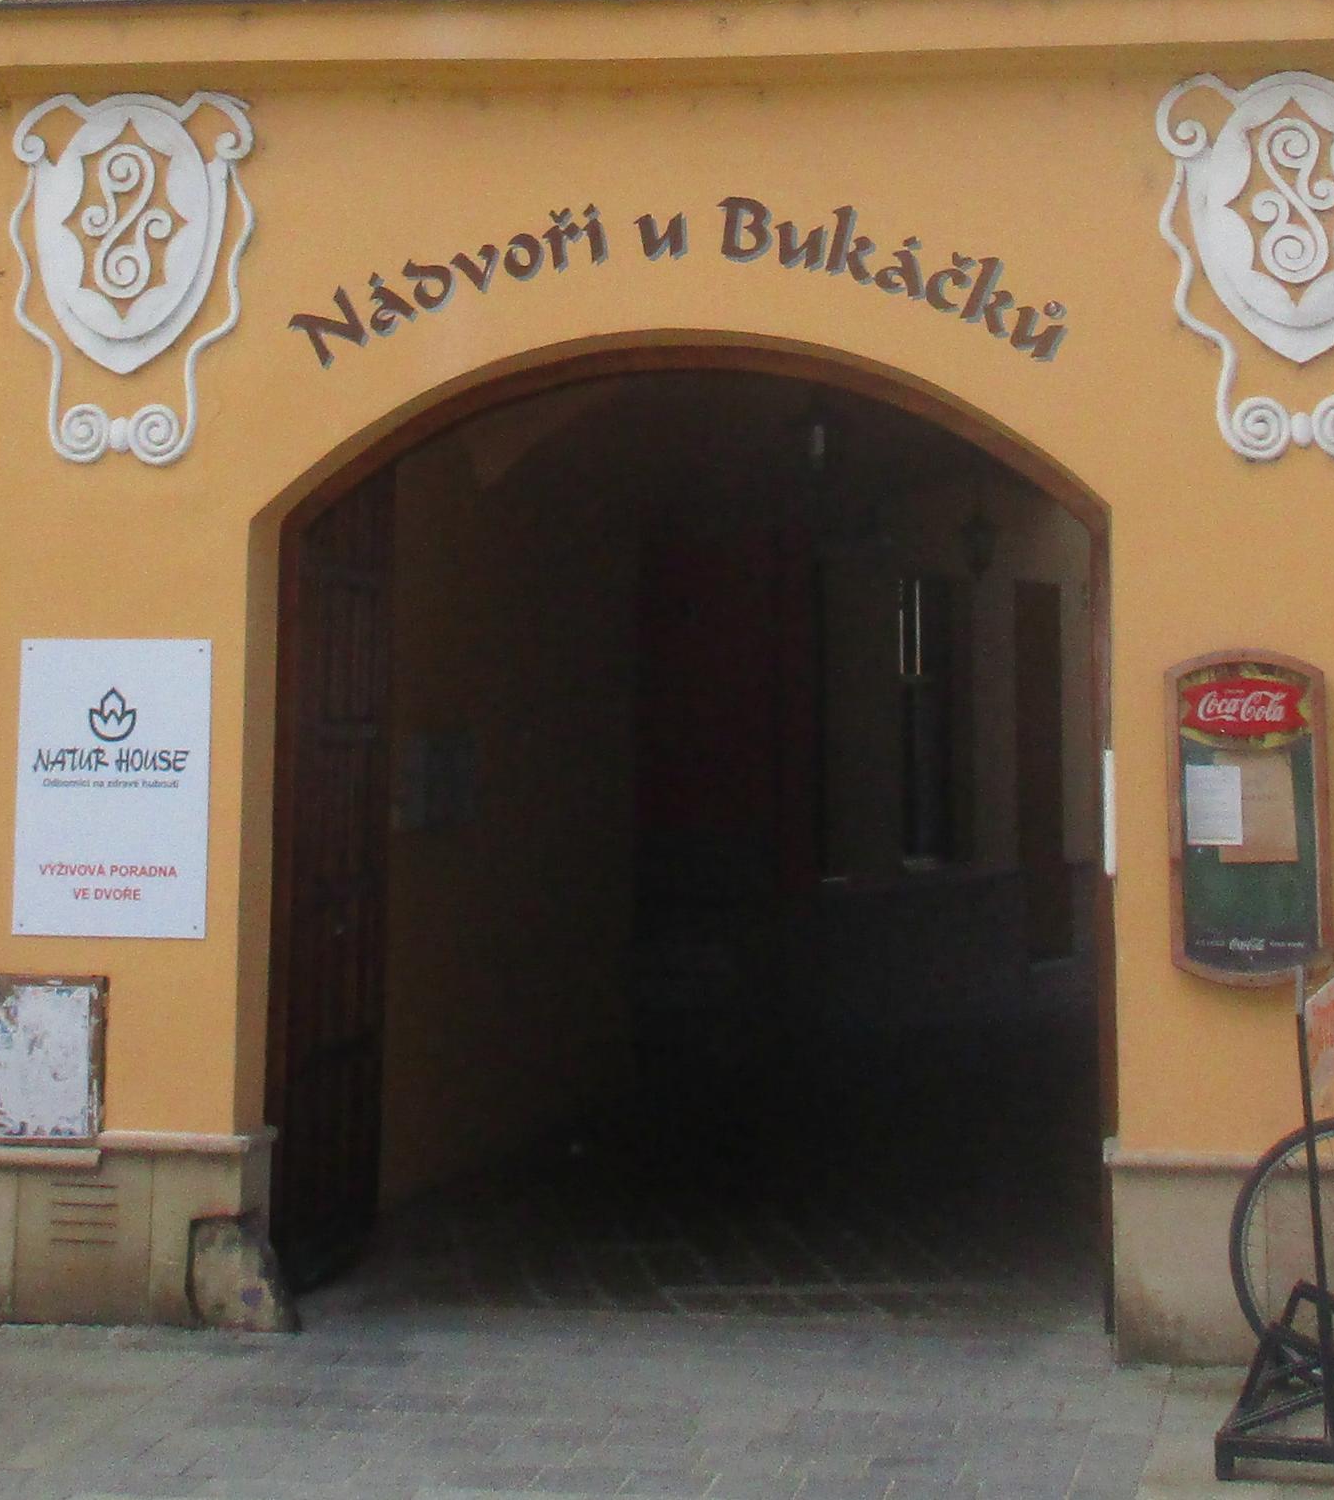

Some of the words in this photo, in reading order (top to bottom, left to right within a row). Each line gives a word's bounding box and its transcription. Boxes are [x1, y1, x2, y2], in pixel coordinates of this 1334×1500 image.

[289, 202, 609, 369] Nádvoří
[635, 211, 689, 259] u
[717, 196, 1068, 363] Bukáčků
[1197, 690, 1287, 722] Coca-Cola
[33, 746, 109, 773] NATUR
[115, 747, 190, 773] HOUSE
[40, 861, 106, 876] VÝŽIVOVÁ
[110, 865, 177, 878] PORADNA
[74, 886, 90, 900] VE
[94, 885, 141, 900] DVOŘE
